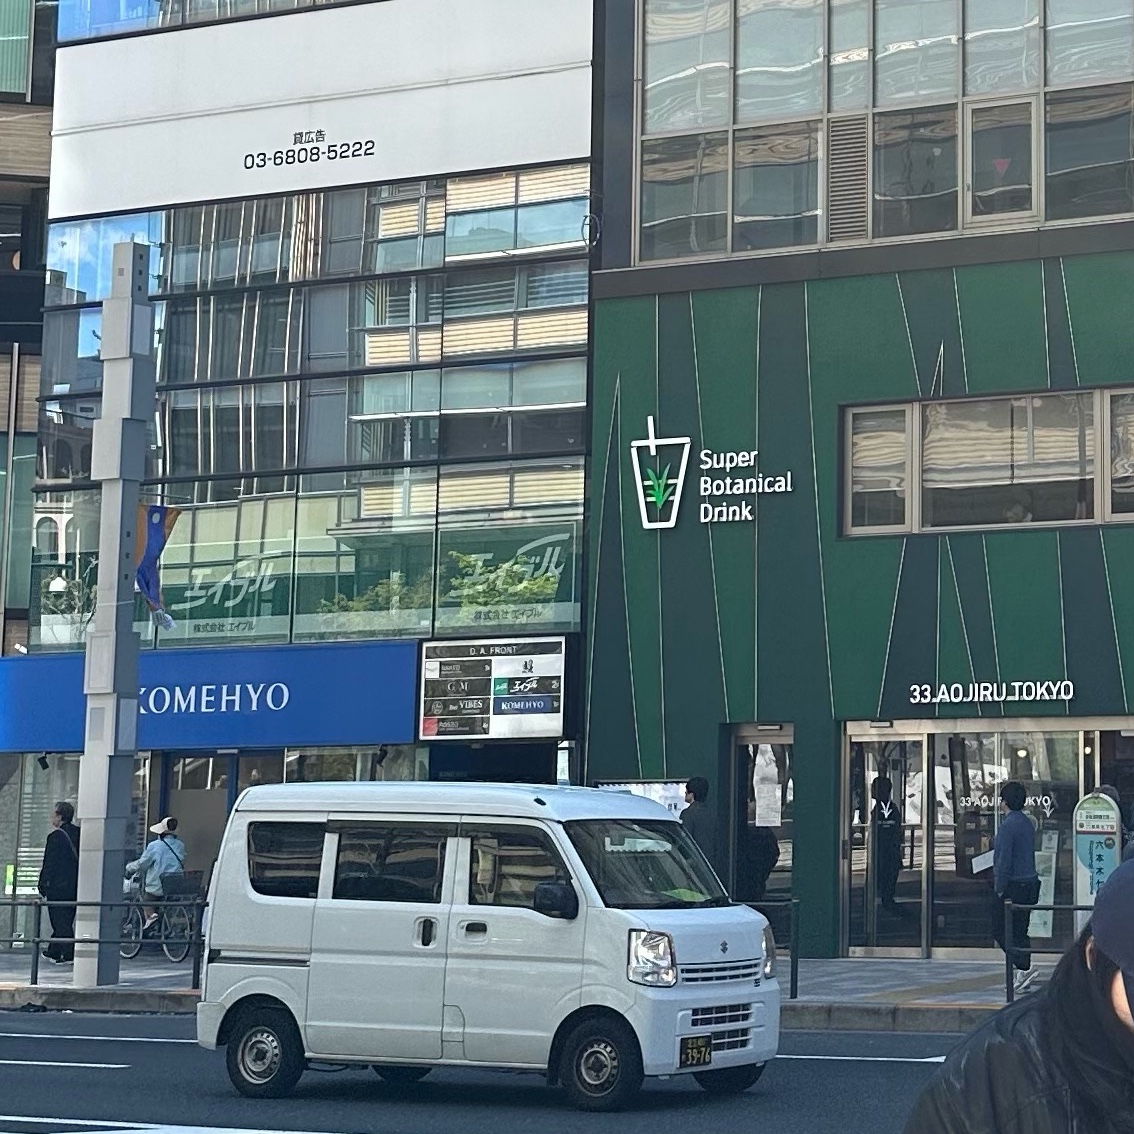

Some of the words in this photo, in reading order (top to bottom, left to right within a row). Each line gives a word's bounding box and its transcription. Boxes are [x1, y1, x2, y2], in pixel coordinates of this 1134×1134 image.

[293, 129, 326, 145] 貸広告
[244, 140, 375, 169] 03-6808-5222
[700, 450, 758, 472] Super
[700, 471, 792, 496] Botanical
[700, 501, 753, 523] Drink
[171, 552, 283, 610] エイブル
[226, 620, 256, 632] エイブル
[909, 685, 931, 704] 33
[936, 682, 1007, 703] AOJIRU
[1011, 680, 1074, 700] TOKYO
[501, 701, 544, 710] KOMEHYO
